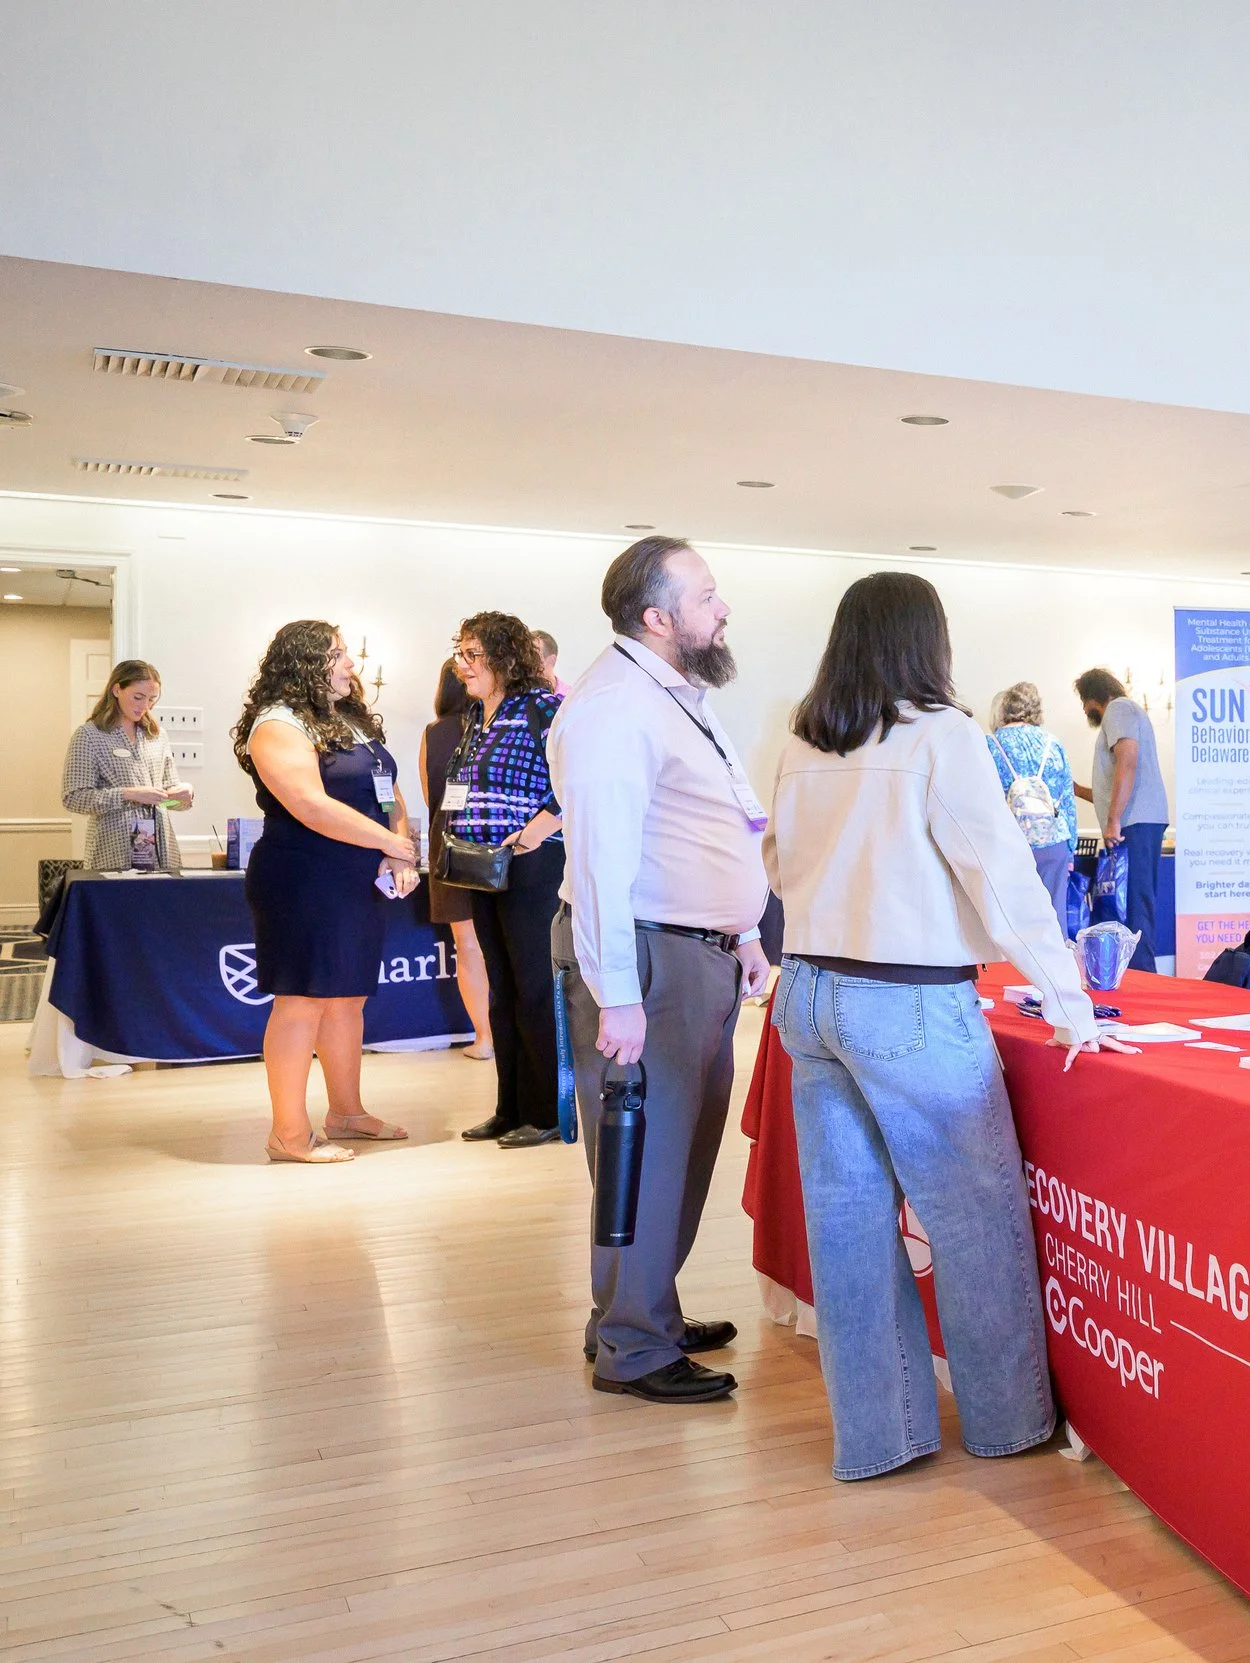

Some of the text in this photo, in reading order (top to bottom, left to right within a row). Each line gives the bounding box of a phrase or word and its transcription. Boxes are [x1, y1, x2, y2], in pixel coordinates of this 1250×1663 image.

[1187, 618, 1217, 626] Mental
[1219, 619, 1247, 627] Health
[1195, 627, 1240, 635] Substance
[1198, 636, 1242, 644] Treatment
[1191, 644, 1242, 653] Adolescents
[1203, 653, 1220, 661] and
[1192, 688, 1246, 723] SUN
[1191, 745, 1249, 763] Delaware
[1184, 848, 1203, 857] Real
[1205, 849, 1244, 859] recovery
[1189, 859, 1206, 867] you
[1208, 857, 1232, 866] need
[1234, 858, 1241, 866] it
[1195, 881, 1236, 891] Brighter
[1197, 921, 1214, 931] GET
[1218, 921, 1235, 930] THE
[1196, 934, 1242, 943] YOU NEED
[1045, 1233, 1162, 1334] CHERRY HILL
[1068, 1298, 1165, 1400] Cooper
